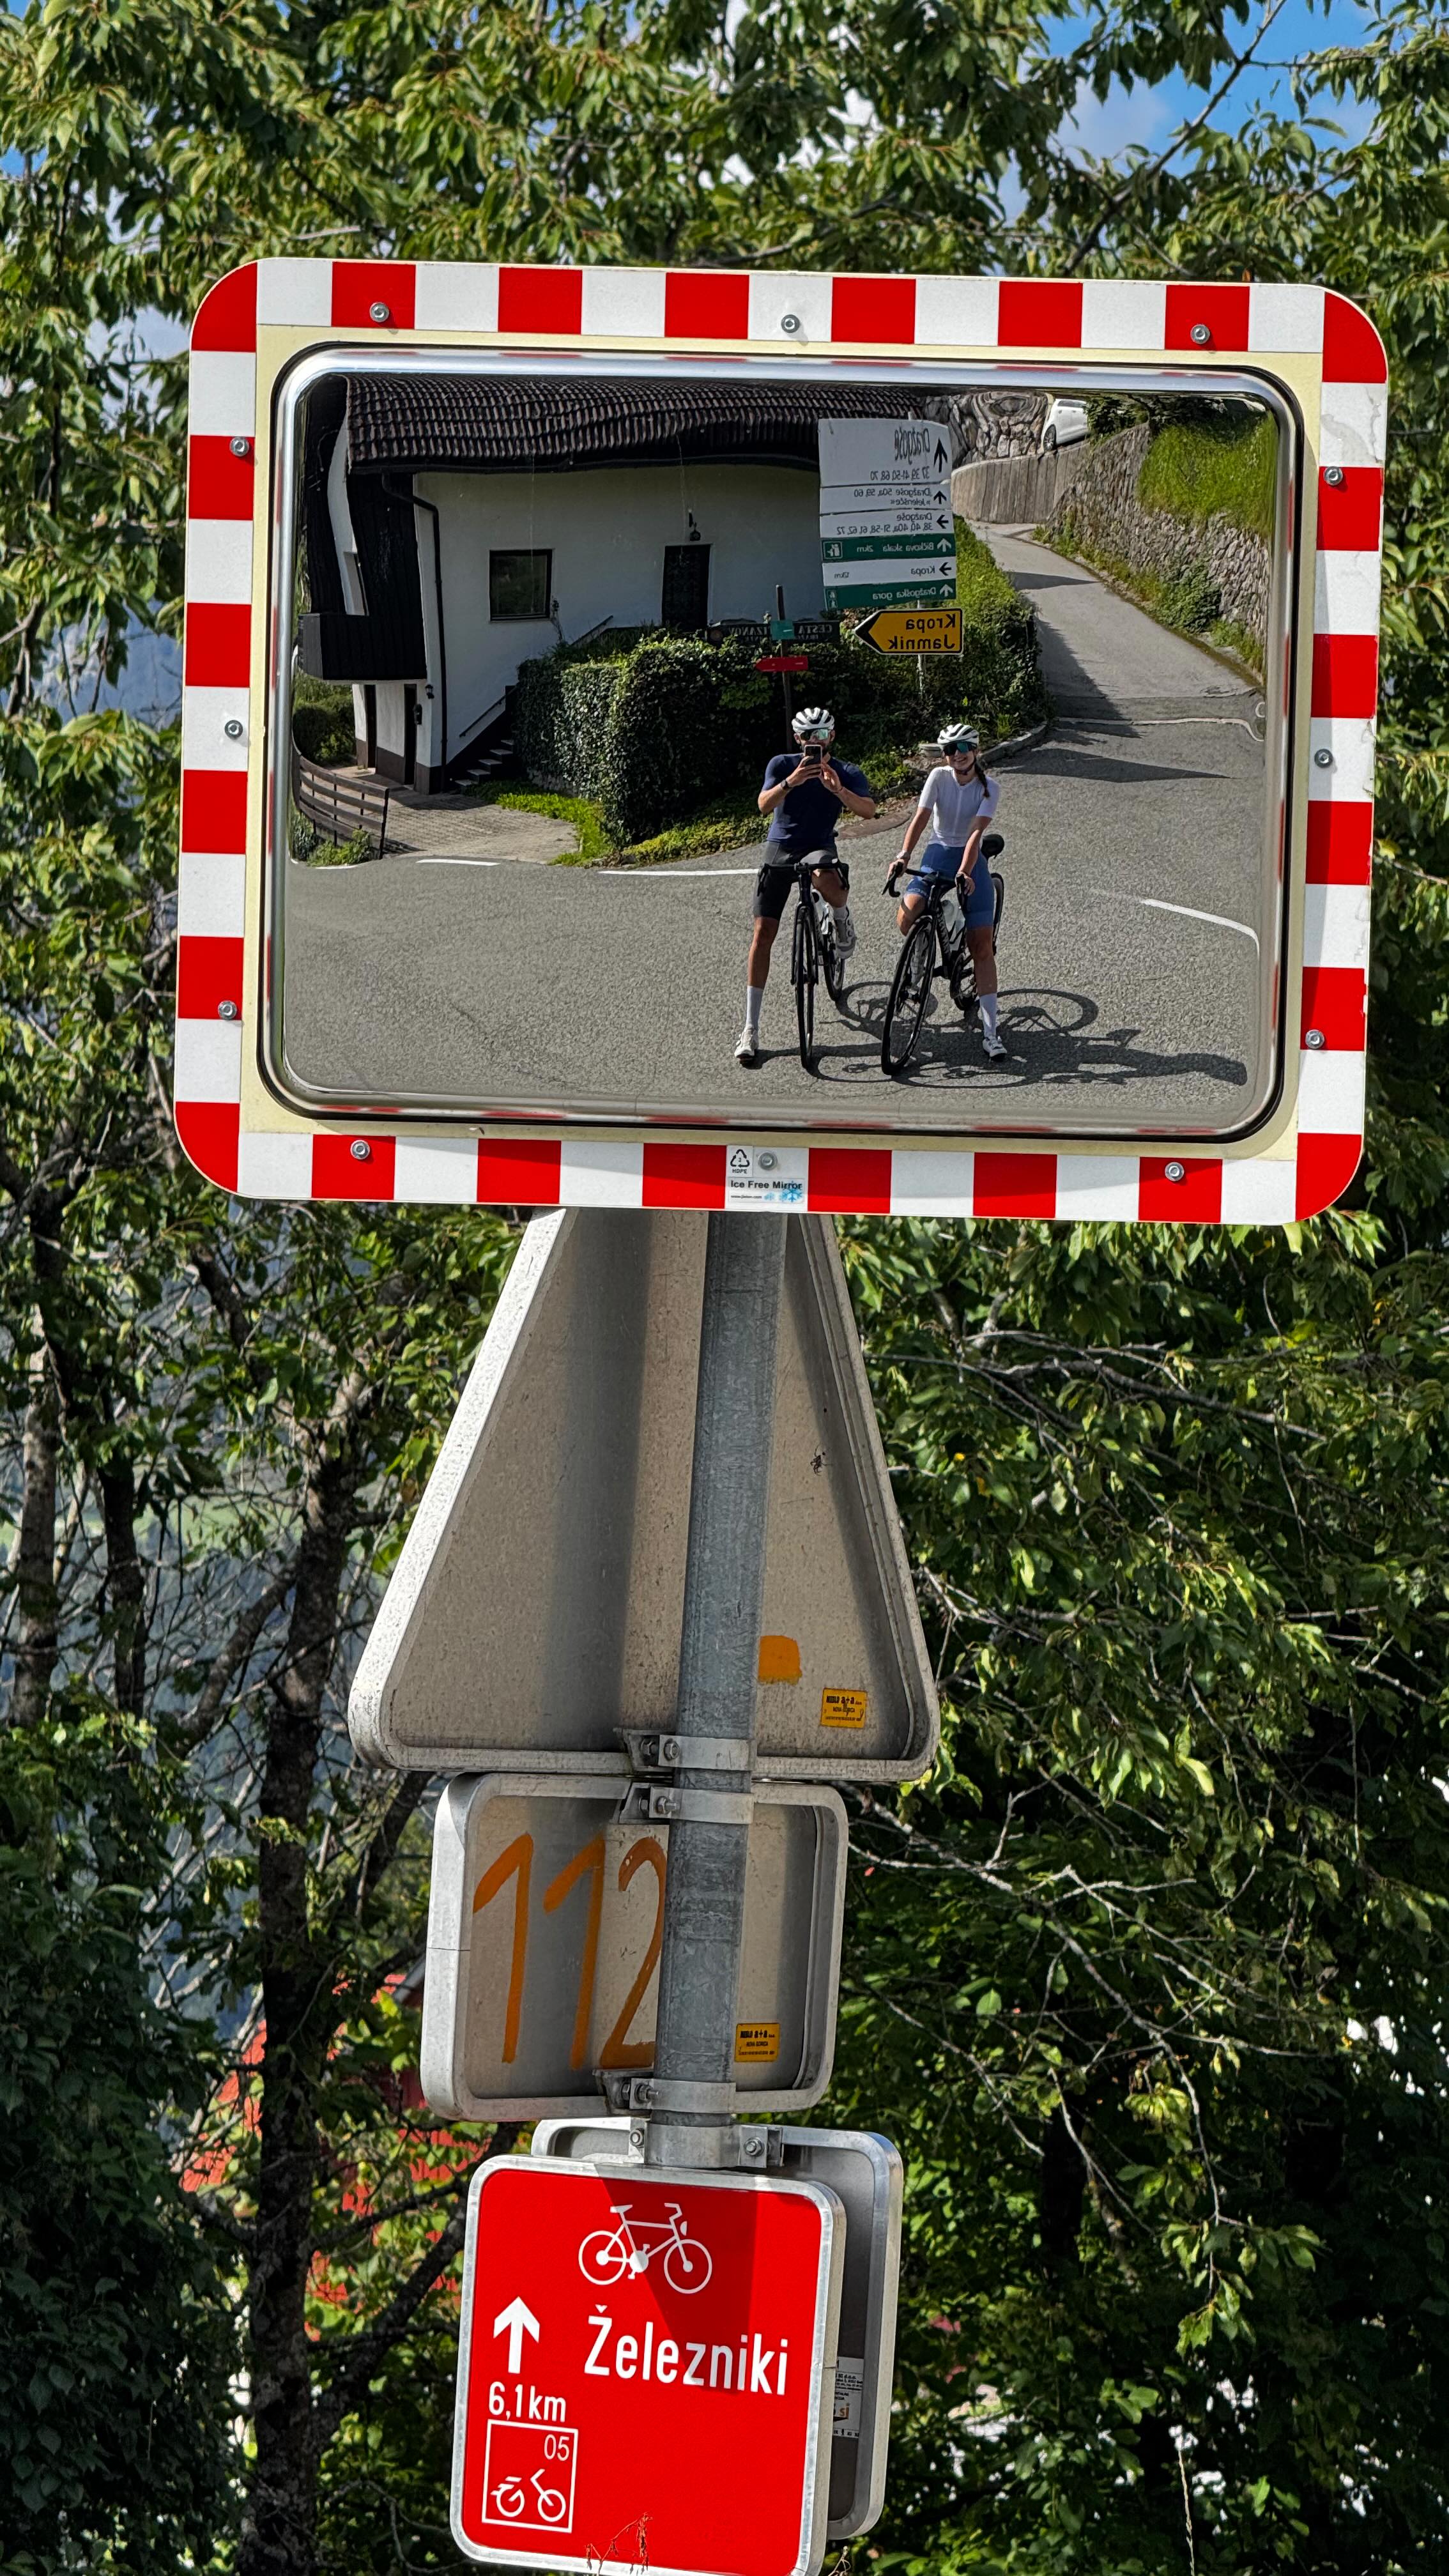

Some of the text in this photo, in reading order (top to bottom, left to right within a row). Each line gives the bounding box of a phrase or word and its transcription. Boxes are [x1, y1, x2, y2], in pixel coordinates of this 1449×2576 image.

[473, 1831, 668, 2070] 112
[585, 2304, 788, 2395] Železniki
[544, 2434, 570, 2461] 05
